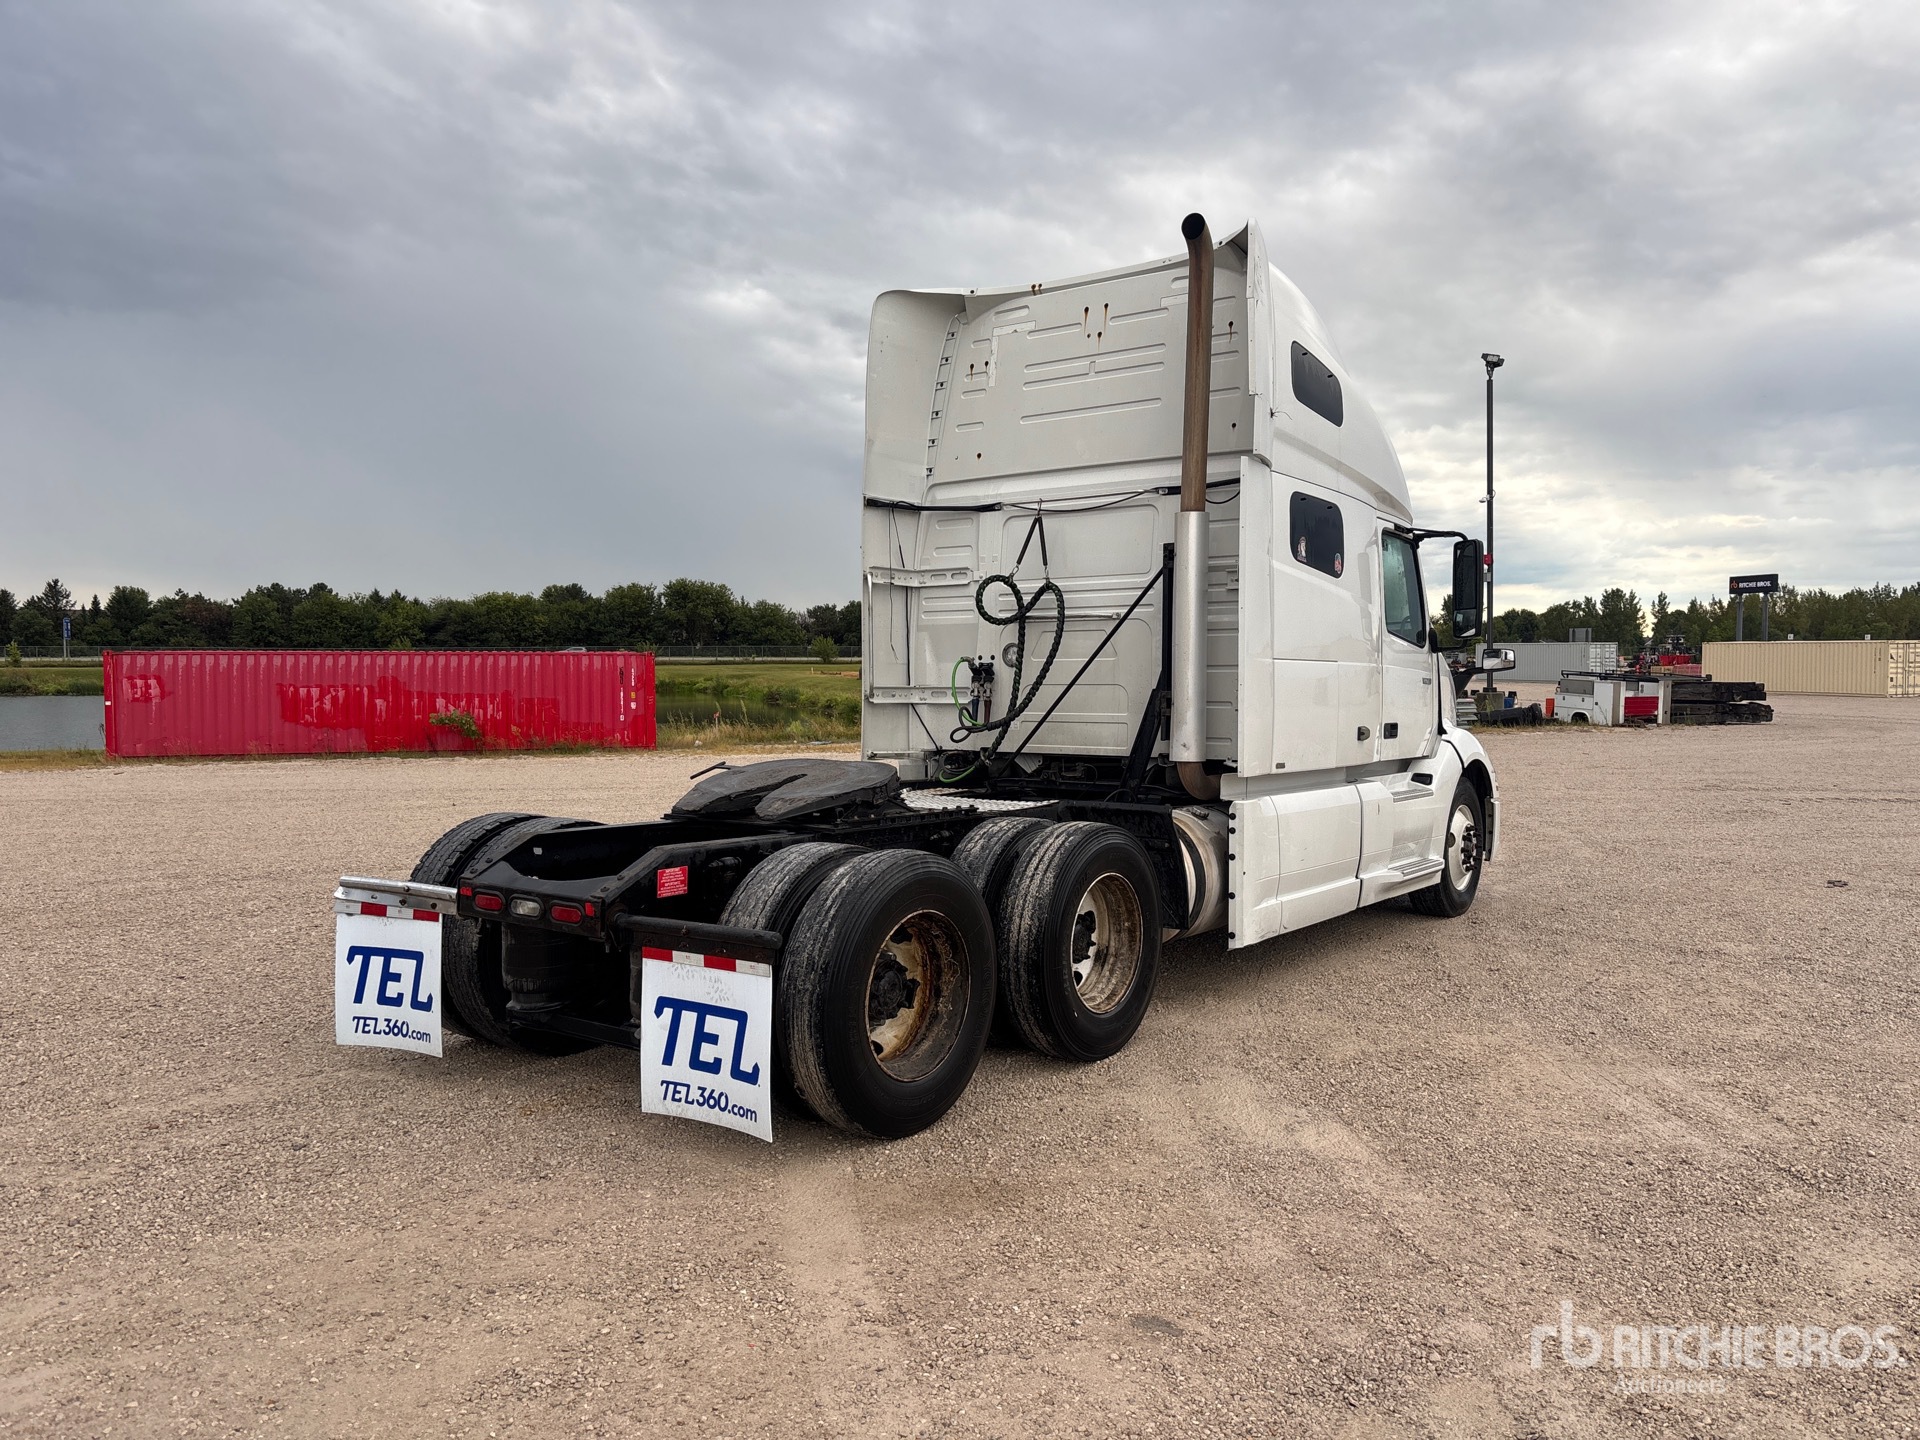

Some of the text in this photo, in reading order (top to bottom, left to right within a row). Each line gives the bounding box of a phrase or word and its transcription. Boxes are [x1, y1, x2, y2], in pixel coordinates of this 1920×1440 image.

[346, 945, 433, 1013] TEL
[352, 1015, 431, 1043] TEL360.com
[654, 995, 760, 1087] TEL
[660, 1079, 757, 1123] TEL360.com
